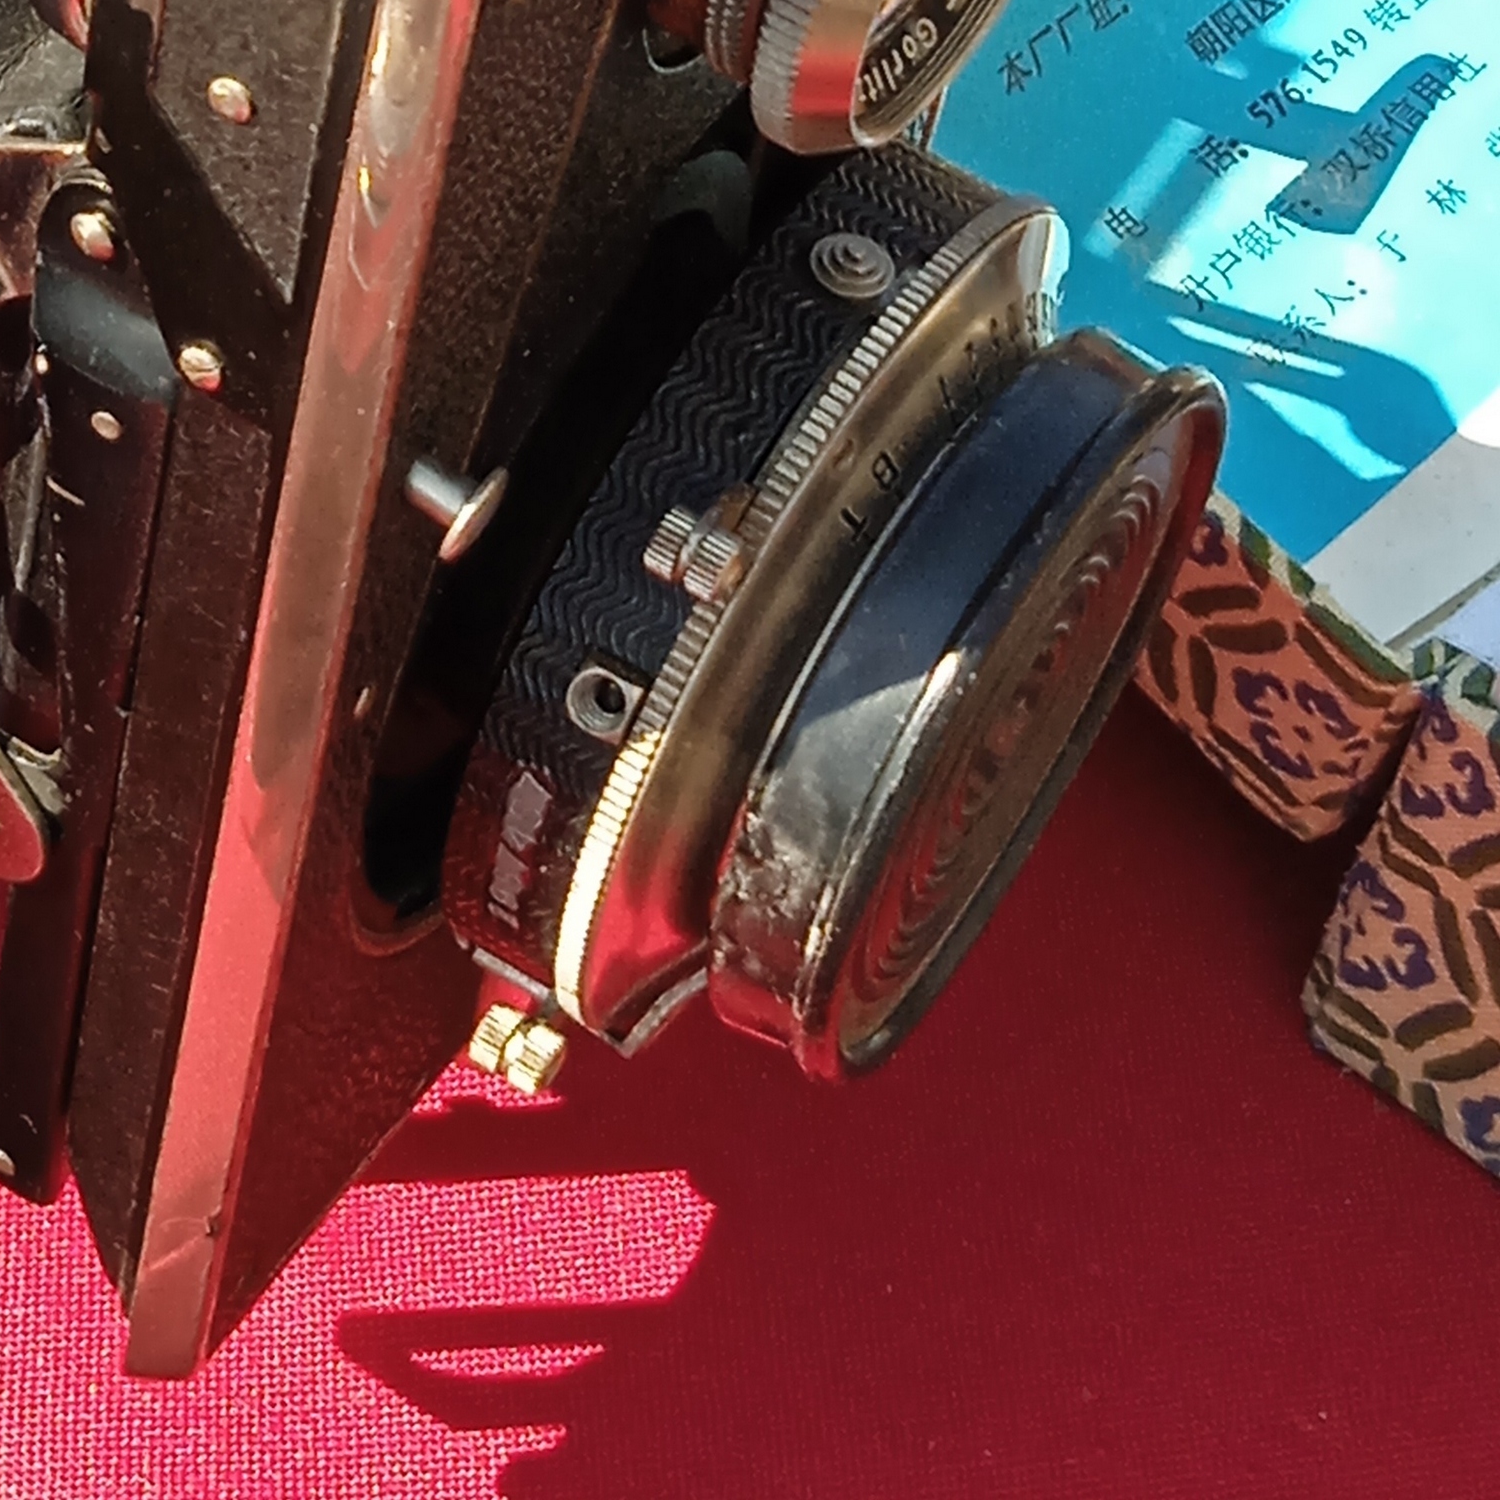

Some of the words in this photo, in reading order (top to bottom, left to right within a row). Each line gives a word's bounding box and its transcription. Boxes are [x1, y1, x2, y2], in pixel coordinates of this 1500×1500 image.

[1319, 51, 1488, 184] 双桥信用社
